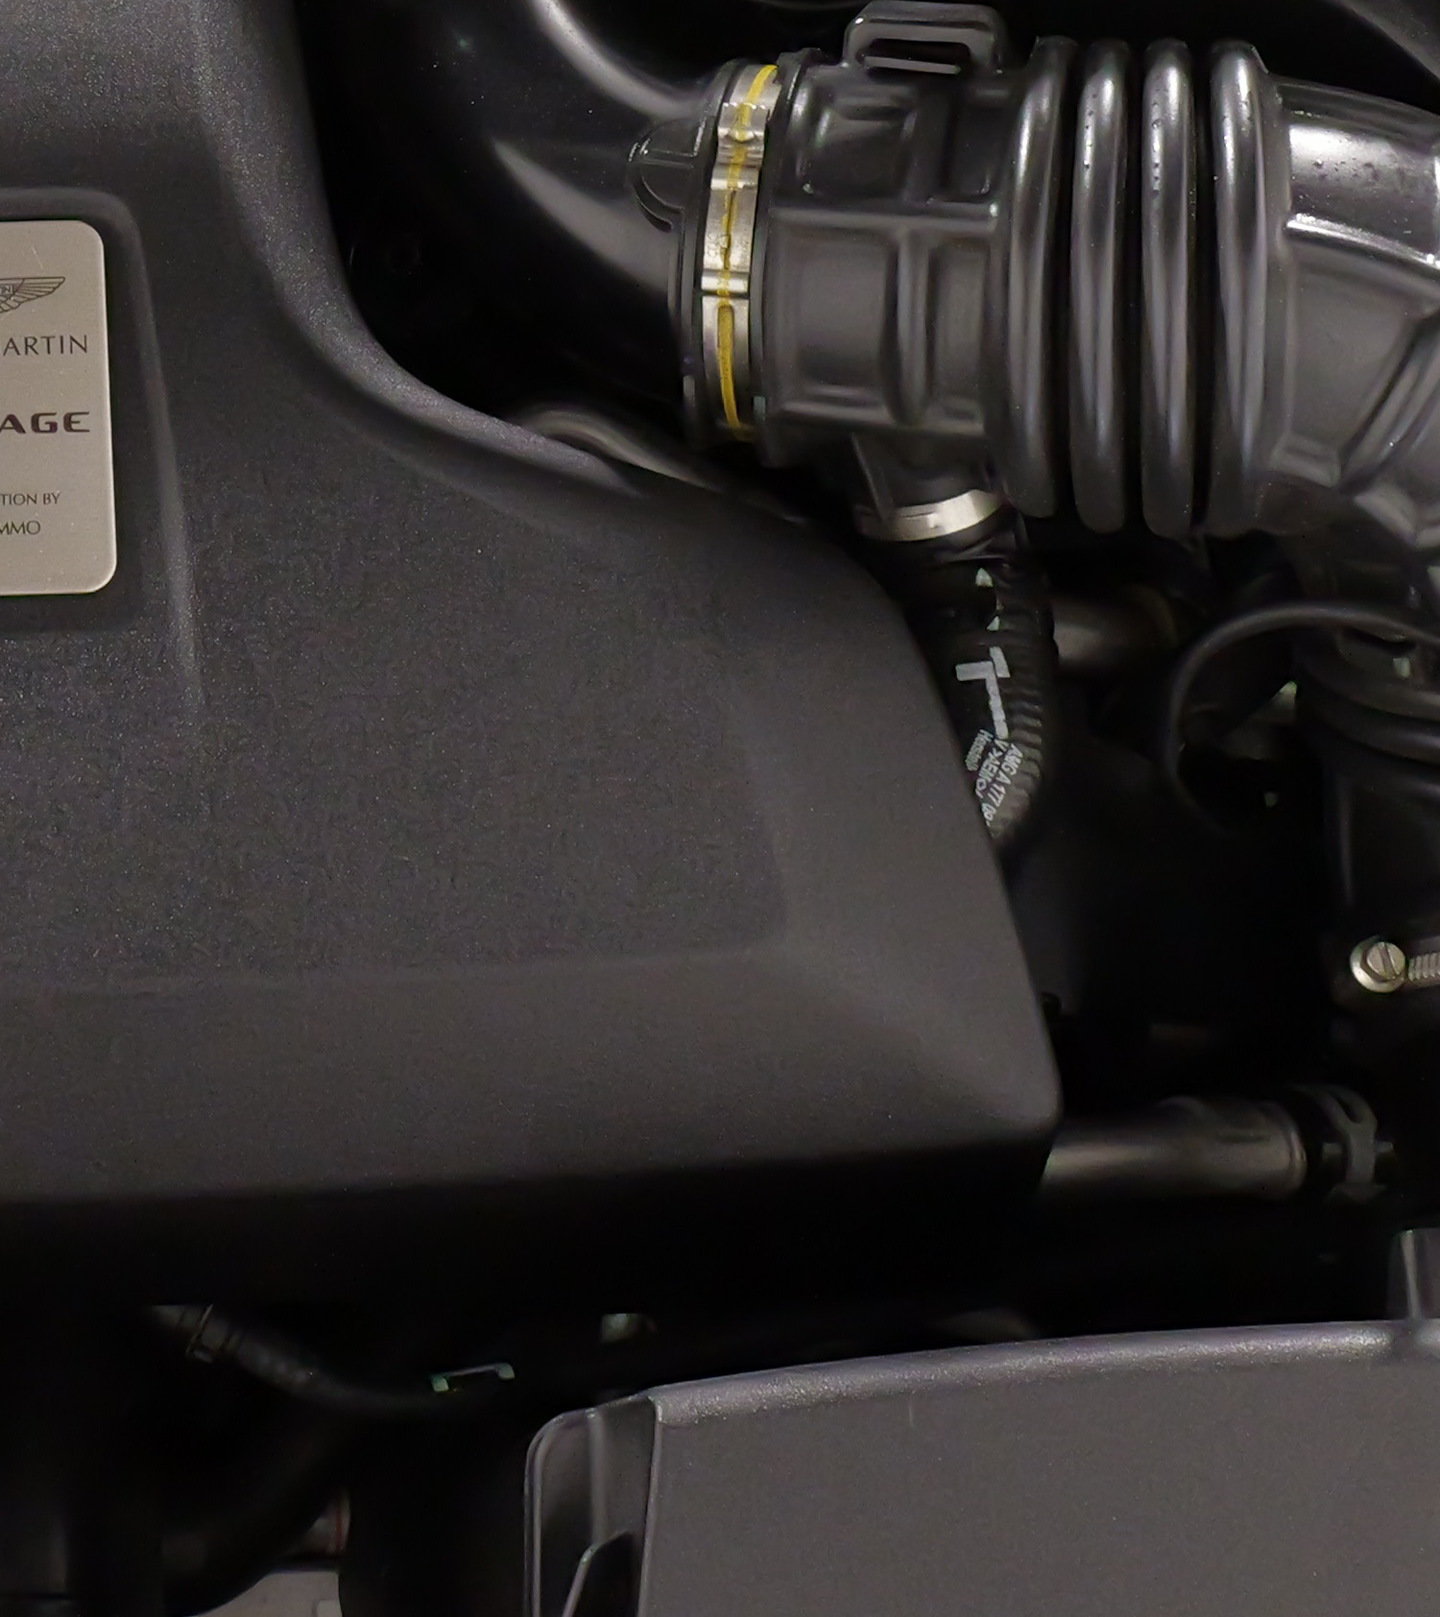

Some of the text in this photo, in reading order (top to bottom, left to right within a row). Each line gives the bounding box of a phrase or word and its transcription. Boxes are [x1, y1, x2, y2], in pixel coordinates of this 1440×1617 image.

[42, 492, 61, 505] BY
[1001, 743, 1024, 775] AMG
[995, 773, 1011, 785] A
[987, 784, 1006, 808] 177
